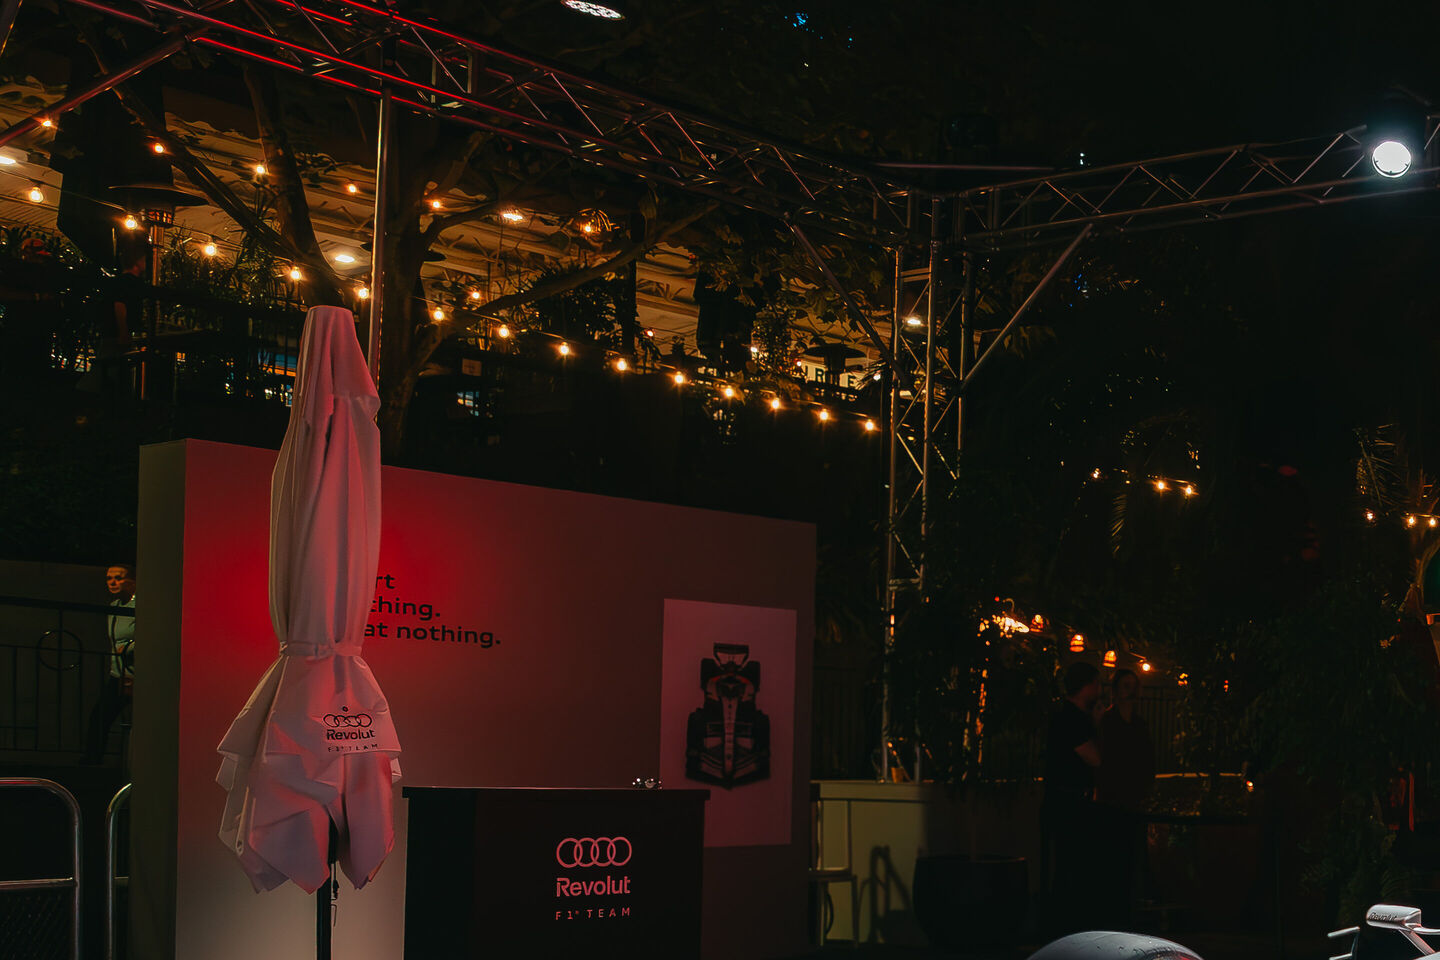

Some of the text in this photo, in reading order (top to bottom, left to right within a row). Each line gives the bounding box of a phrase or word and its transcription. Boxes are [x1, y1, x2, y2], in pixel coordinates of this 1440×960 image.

[397, 625, 501, 649] nothing.
[326, 728, 376, 740] Revolut
[556, 875, 631, 898] Revolut
[586, 906, 631, 919] TEAM
